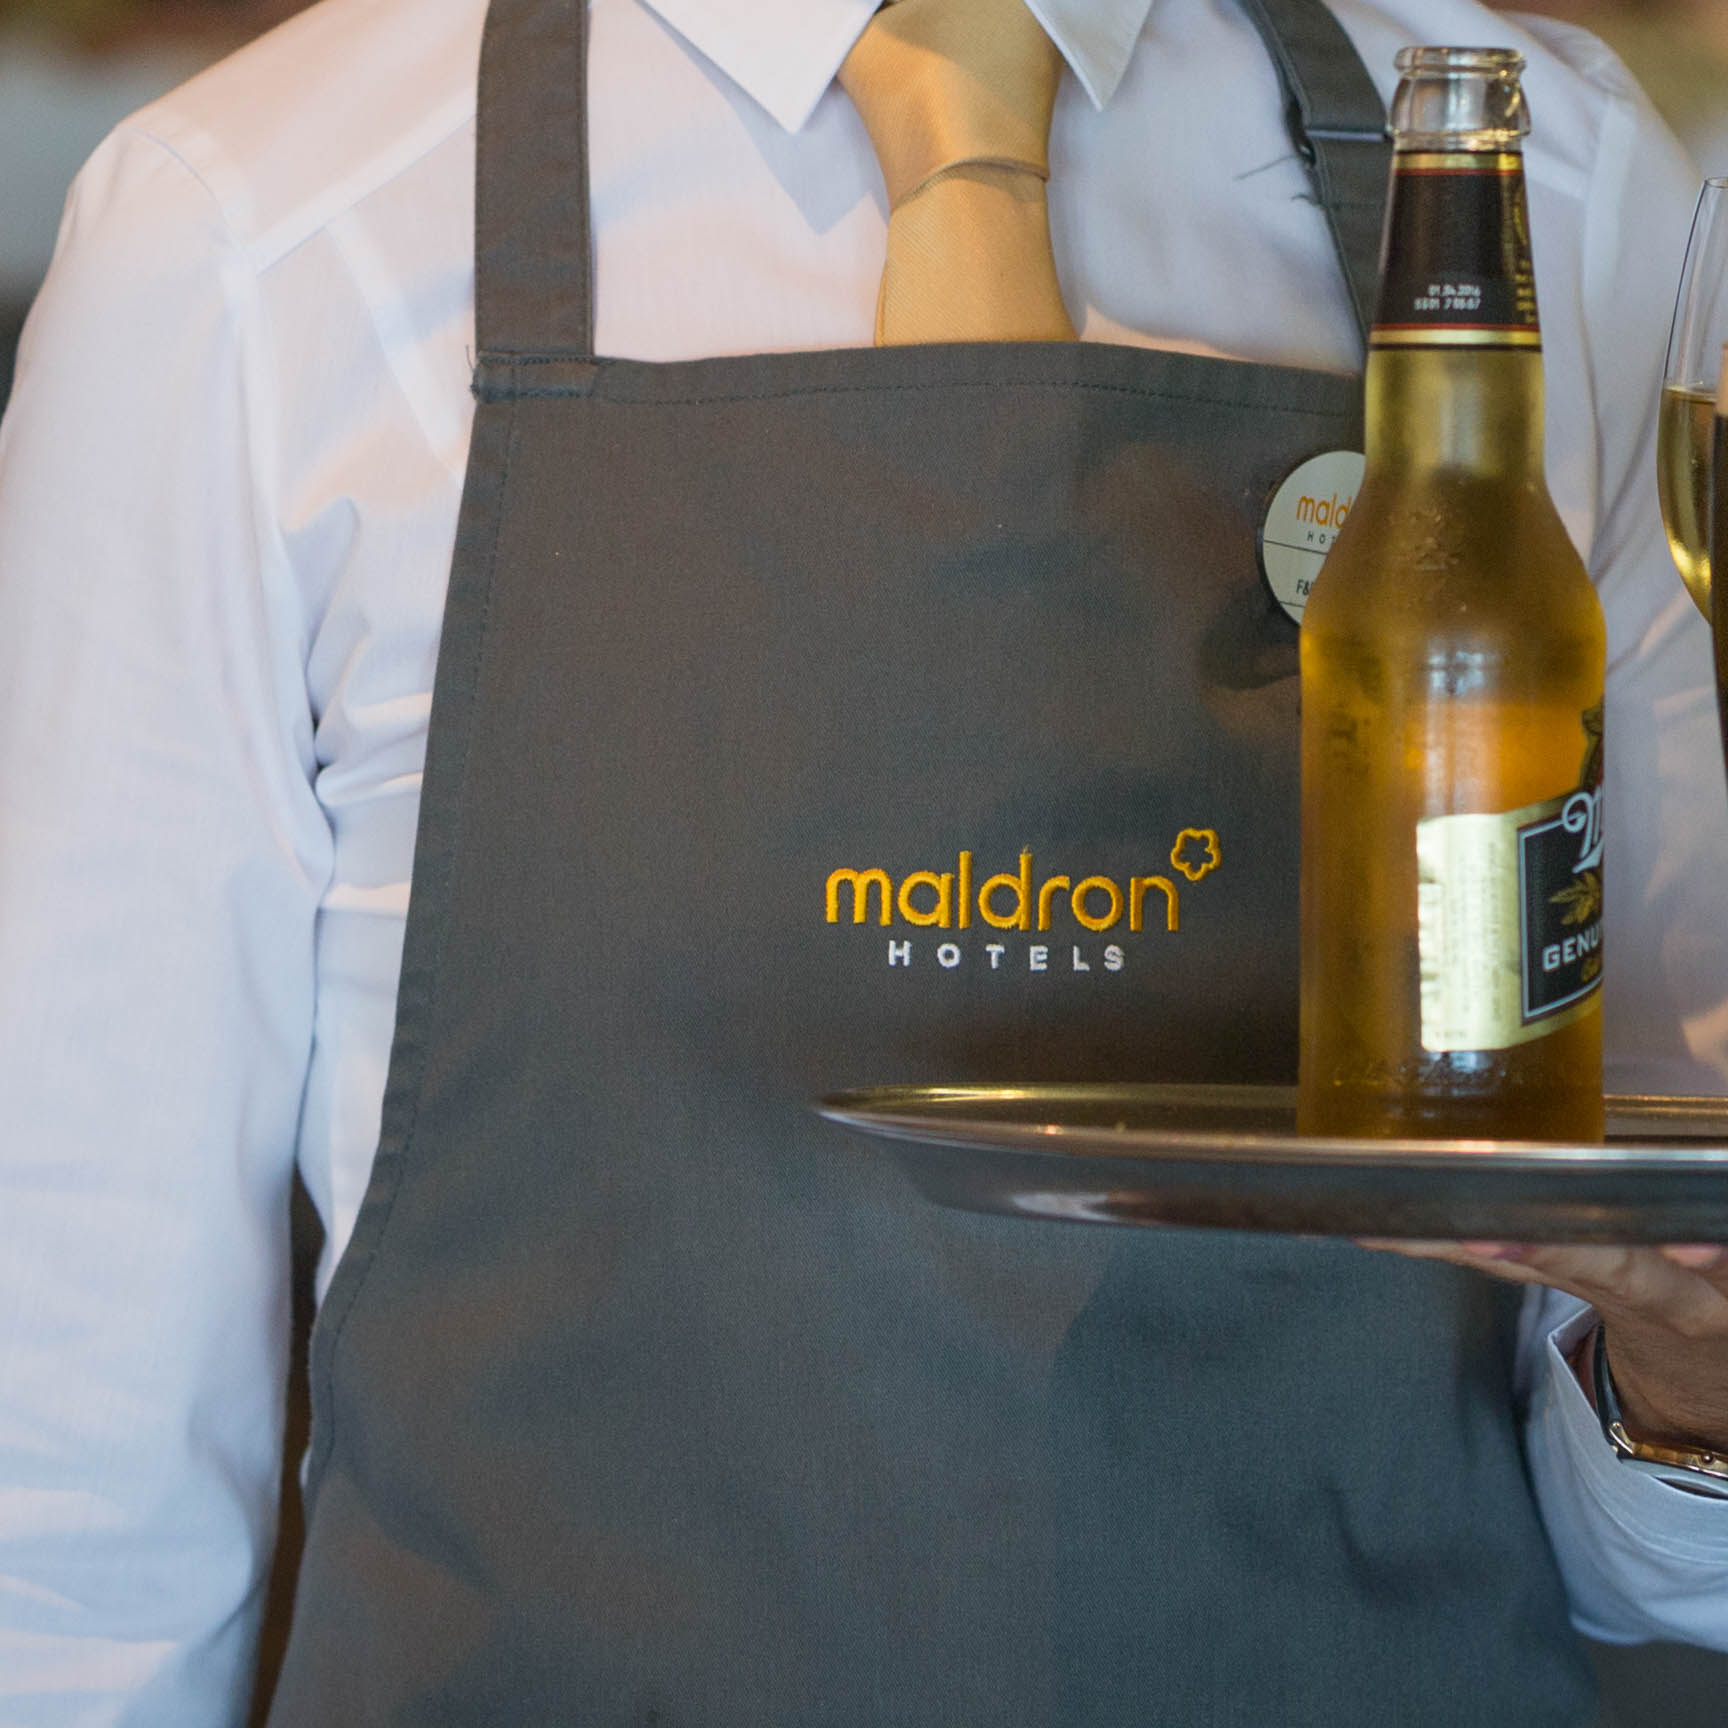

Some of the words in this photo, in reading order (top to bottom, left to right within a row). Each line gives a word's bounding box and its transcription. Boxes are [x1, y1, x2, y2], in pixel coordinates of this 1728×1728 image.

[1296, 493, 1352, 530] mald
[1296, 579, 1314, 596] F&
[825, 849, 1179, 932] maldron
[888, 940, 1126, 972] HOTELS
